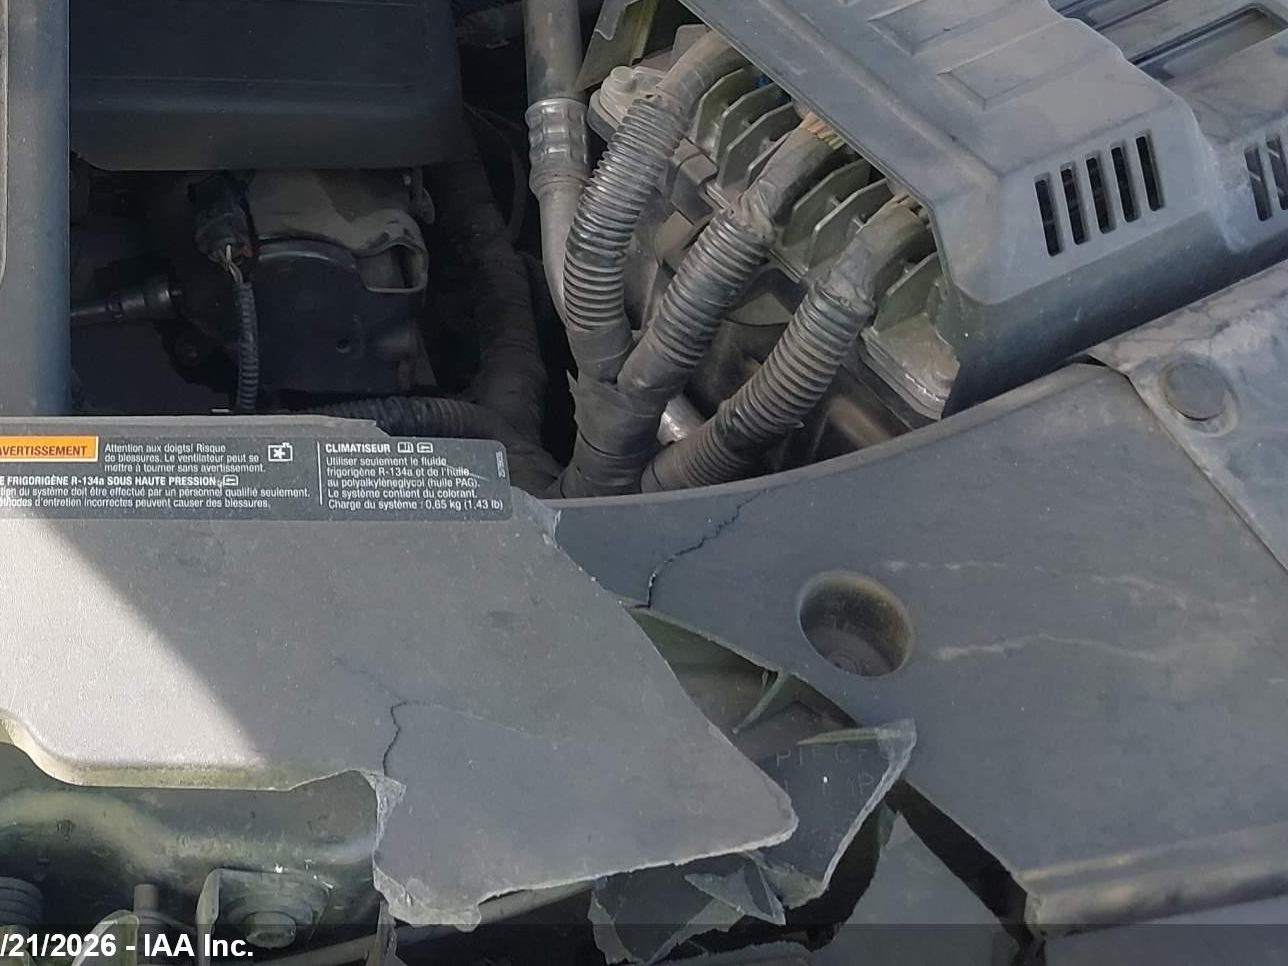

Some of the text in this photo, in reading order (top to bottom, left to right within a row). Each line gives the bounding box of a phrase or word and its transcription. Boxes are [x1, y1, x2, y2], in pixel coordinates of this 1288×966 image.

[104, 443, 226, 455] Attention aux doigts! Risque
[325, 443, 391, 453] CLIMATISEUR
[104, 452, 260, 465] de blessures. Le ventilateur peut se
[325, 456, 447, 466] Utiliser seulement le fluide
[104, 463, 133, 473] mettre
[143, 463, 176, 473] tourner
[177, 464, 198, 473] sans
[200, 463, 266, 473] avertissement.
[327, 466, 470, 478] frigorigène R-134a et de l'huile
[7, 474, 68, 485] FRIGORIGÈNE
[71, 475, 105, 485] R-134a
[107, 476, 132, 486] SOUS
[135, 476, 166, 486] HAUTE
[168, 476, 216, 486] PRESSION
[327, 478, 481, 489] au polyalkylèneglycol (huile PAG).
[19, 486, 30, 497] du
[32, 486, 68, 498] système
[70, 486, 88, 497] doit
[89, 486, 107, 497] être
[109, 487, 145, 497] effectué
[147, 488, 162, 499] par
[164, 488, 176, 497] un
[178, 487, 223, 499] personnel
[225, 487, 258, 499] qualifié
[260, 487, 310, 498] seulement.
[327, 488, 478, 500] Le système contient du colorant.
[34, 497, 81, 507] d'entretien
[84, 497, 133, 507] incorrectes
[135, 498, 170, 509] peuvent
[173, 498, 203, 508] causer
[205, 498, 222, 508] des
[224, 498, 271, 508] blessures.
[328, 499, 361, 510] Charge
[363, 499, 376, 509] du
[378, 499, 418, 511] système
[449, 499, 462, 511] kg
[491, 499, 504, 511] lb)
